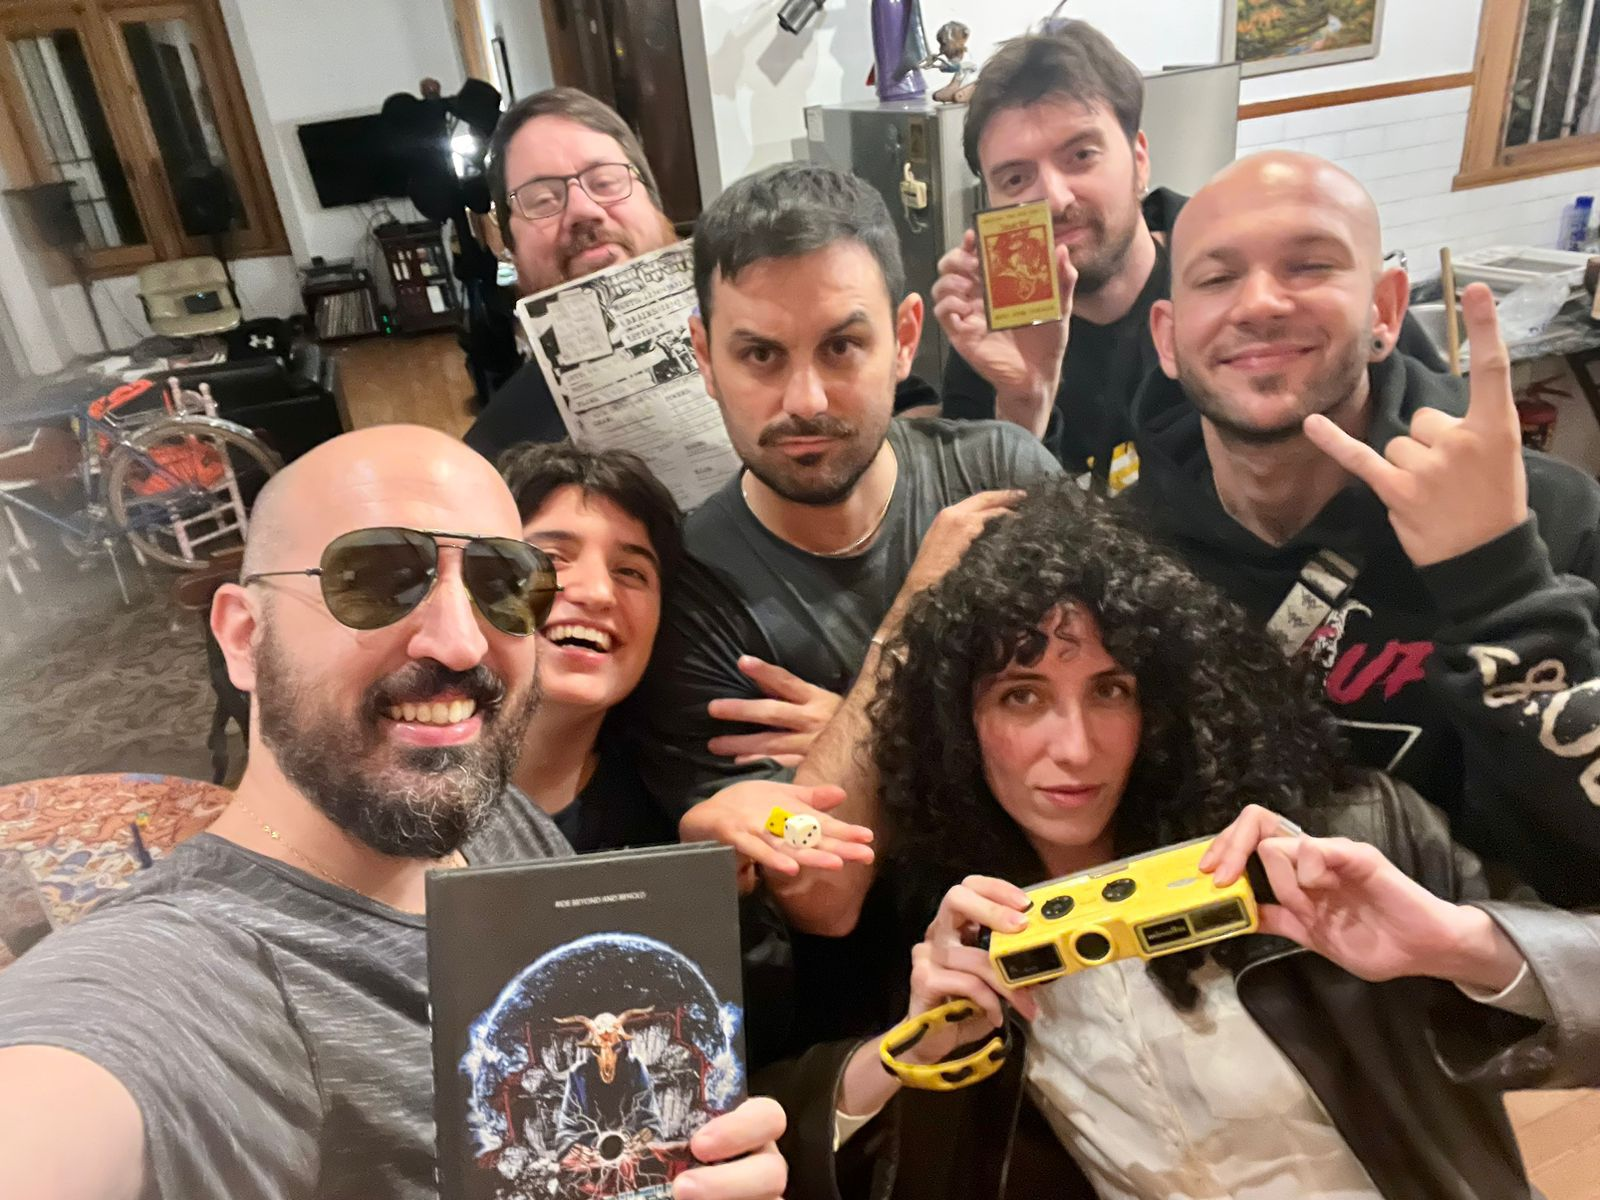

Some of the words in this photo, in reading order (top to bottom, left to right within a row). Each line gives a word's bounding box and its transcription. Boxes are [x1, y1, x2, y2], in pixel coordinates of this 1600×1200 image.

[571, 896, 601, 906] BEYOND
[602, 894, 617, 903] AND
[618, 891, 646, 901] BEHOLD
